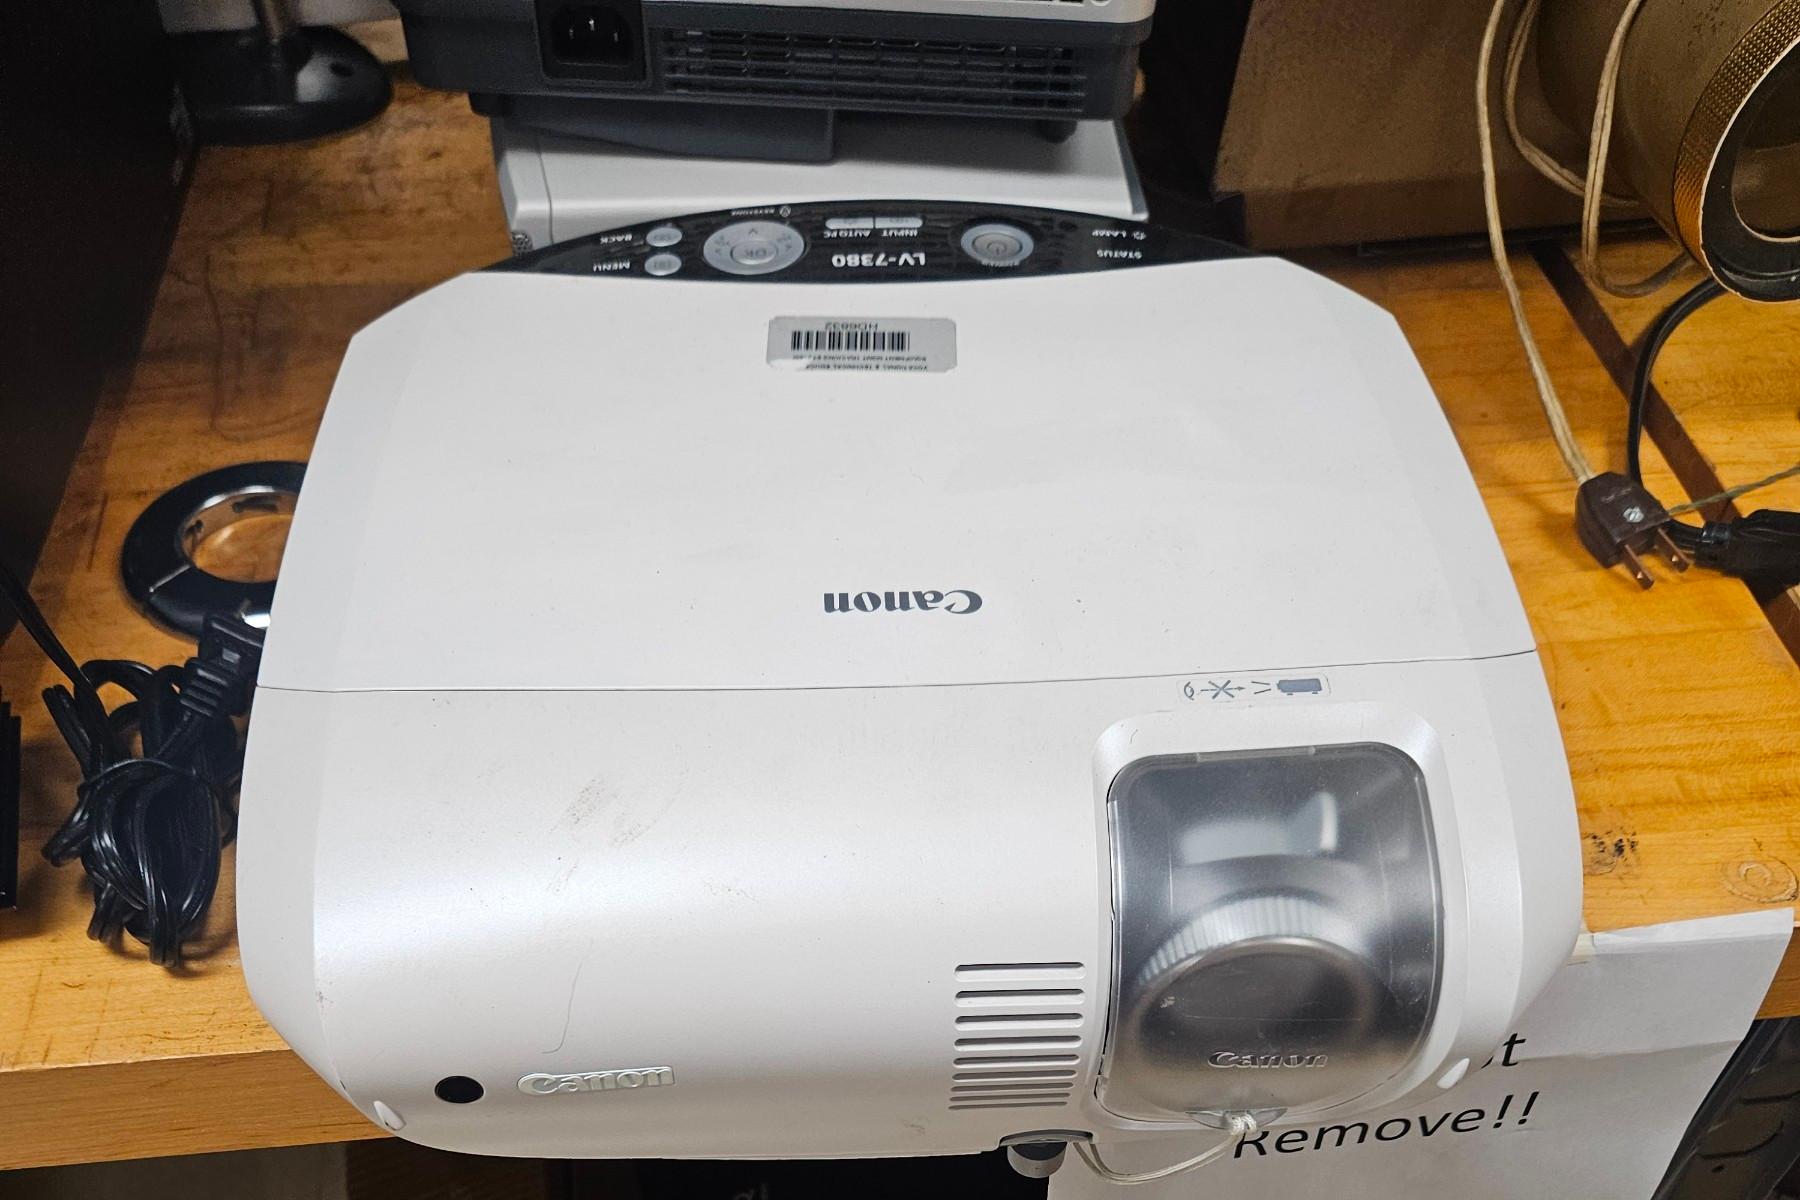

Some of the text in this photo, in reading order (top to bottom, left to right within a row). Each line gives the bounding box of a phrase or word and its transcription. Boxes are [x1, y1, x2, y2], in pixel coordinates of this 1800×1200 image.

[600, 233, 633, 244] BACK
[823, 230, 871, 238] AUTO PC
[881, 229, 918, 238] INPUT
[831, 252, 926, 268] LV-7380
[1096, 249, 1143, 259] STATUS
[593, 260, 631, 272] MENU
[823, 589, 983, 615] Canon
[1207, 1051, 1329, 1069] Canon
[517, 1065, 675, 1096] Canon
[1233, 1090, 1540, 1159] Remove!!
